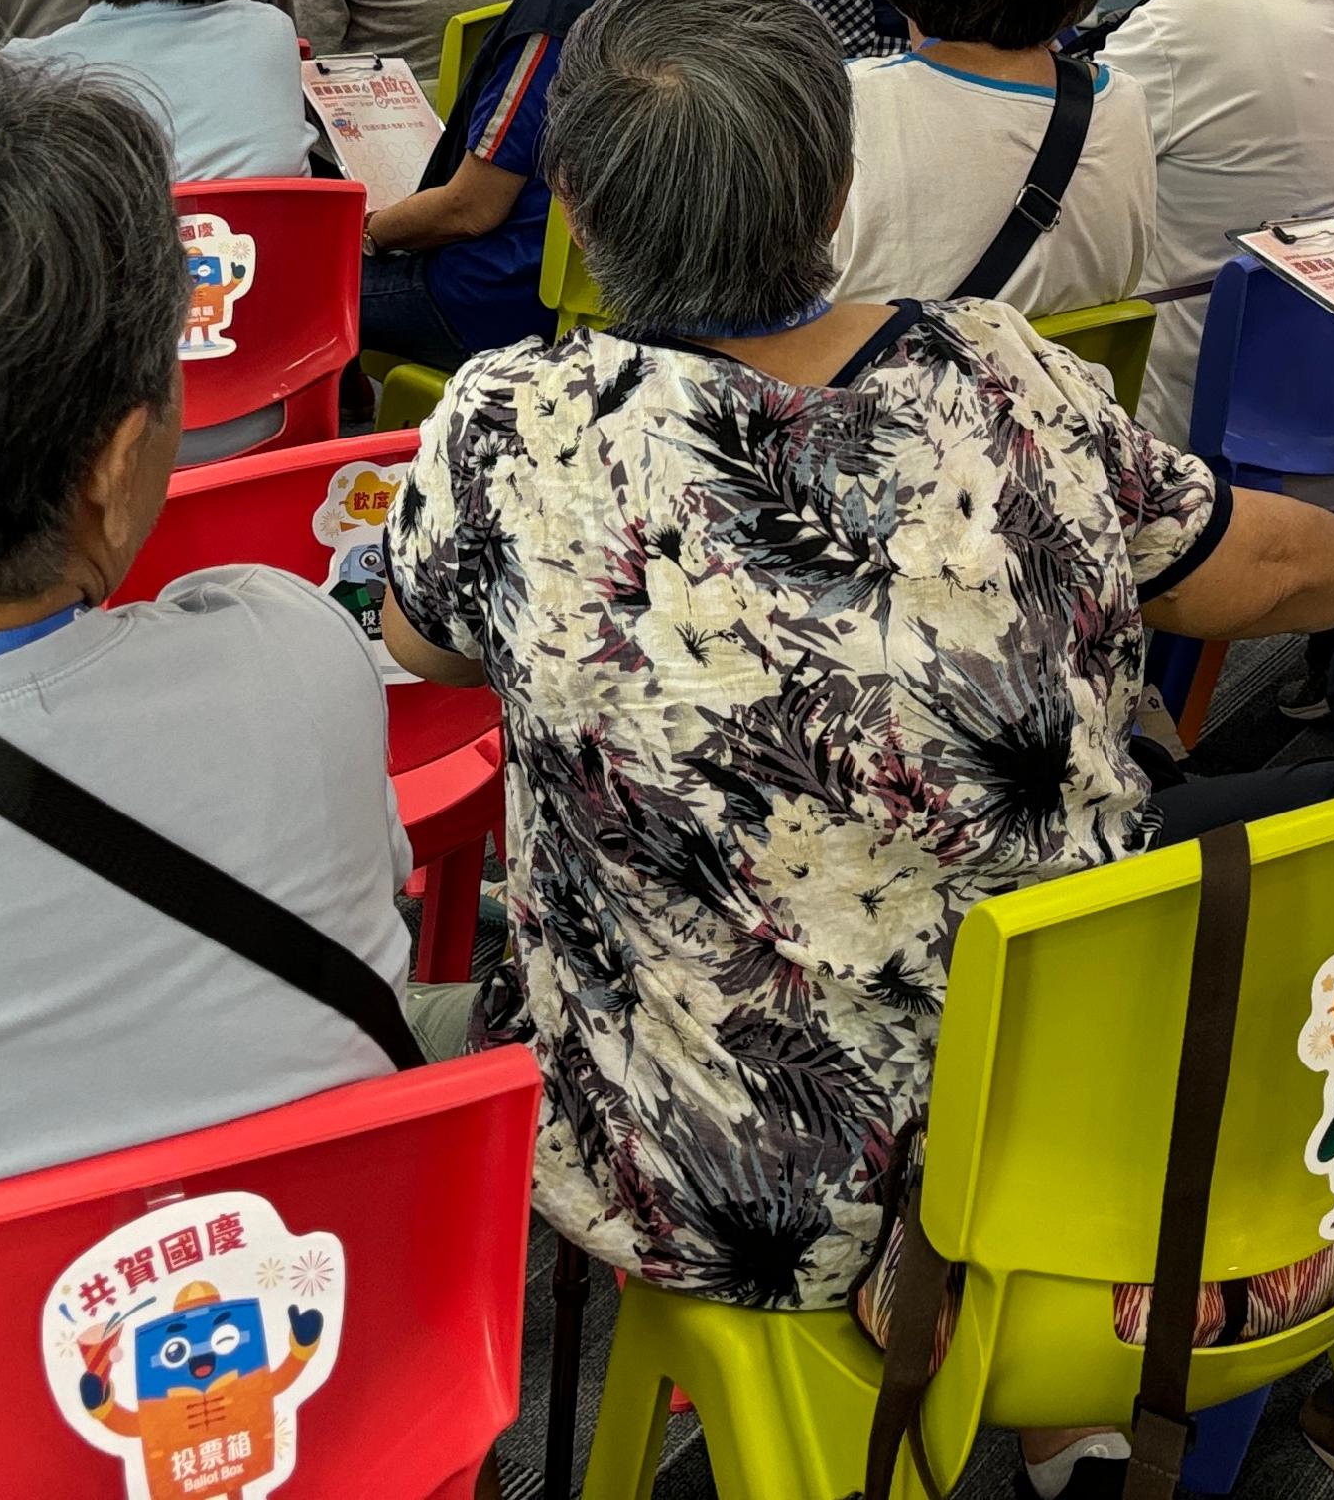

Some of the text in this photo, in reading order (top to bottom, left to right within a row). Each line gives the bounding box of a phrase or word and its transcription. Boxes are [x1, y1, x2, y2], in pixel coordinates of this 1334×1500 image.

[370, 76, 415, 97] 開放日
[78, 1211, 249, 1316] 共賀國慶
[171, 1430, 252, 1482] 投票箱
[182, 1461, 245, 1493] Ballot Box
